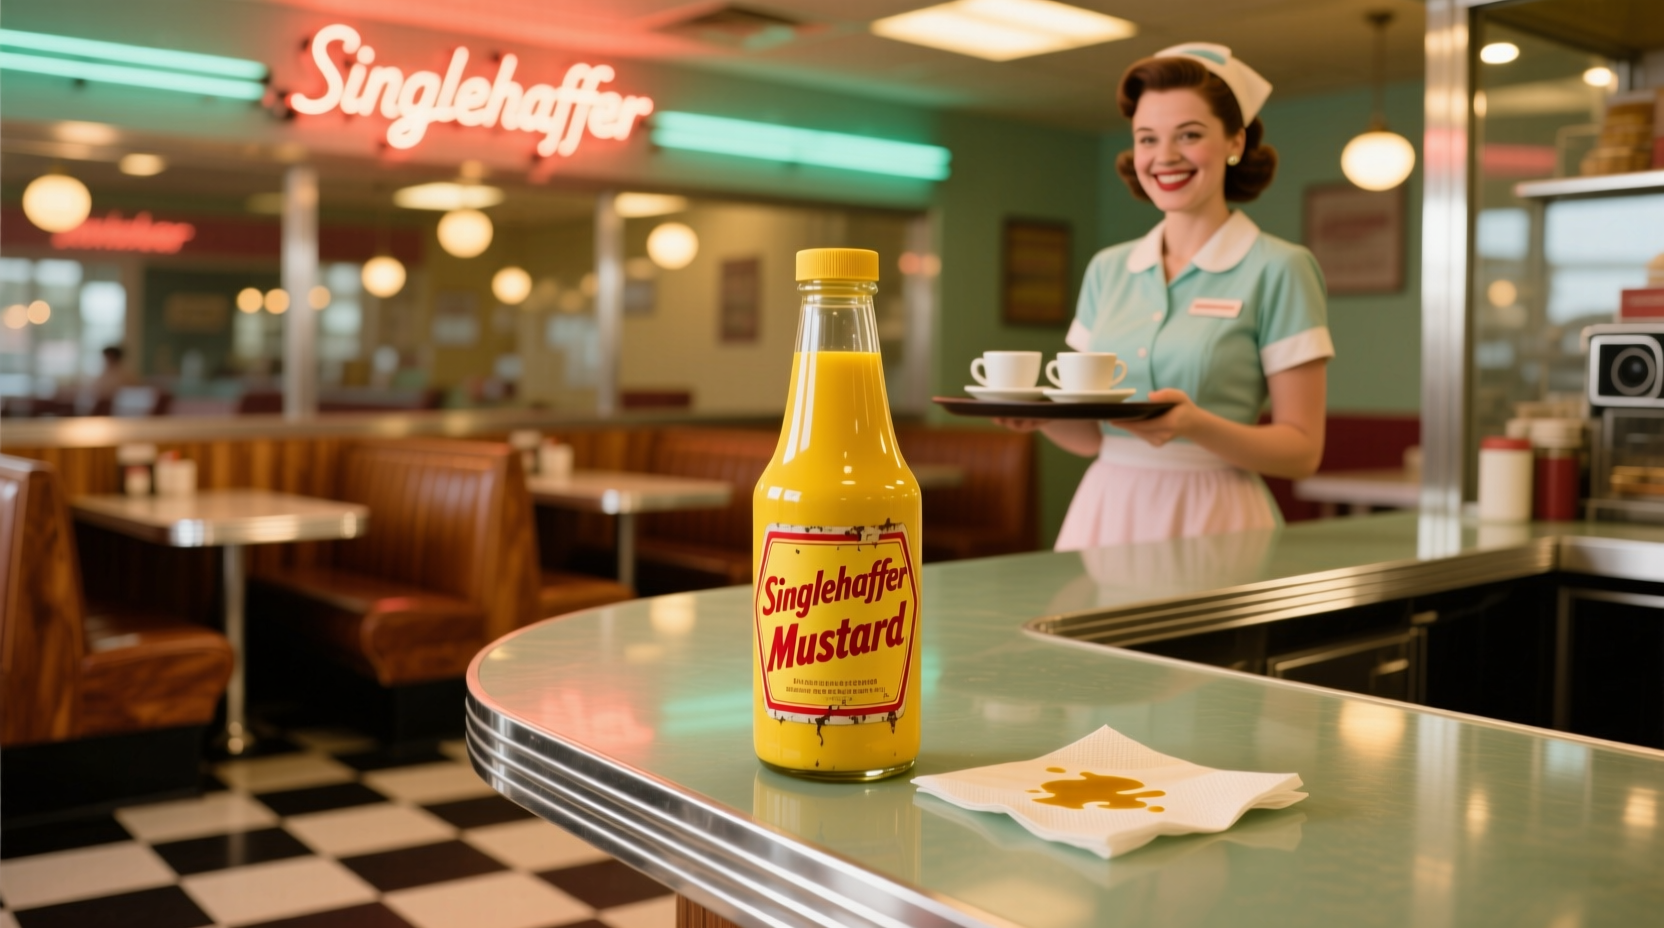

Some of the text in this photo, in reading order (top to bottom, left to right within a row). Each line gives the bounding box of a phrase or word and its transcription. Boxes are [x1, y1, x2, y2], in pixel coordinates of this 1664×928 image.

[291, 23, 654, 157] Singlehaffer
[762, 557, 907, 618] Singlehaffer
[767, 600, 907, 672] Mustard
